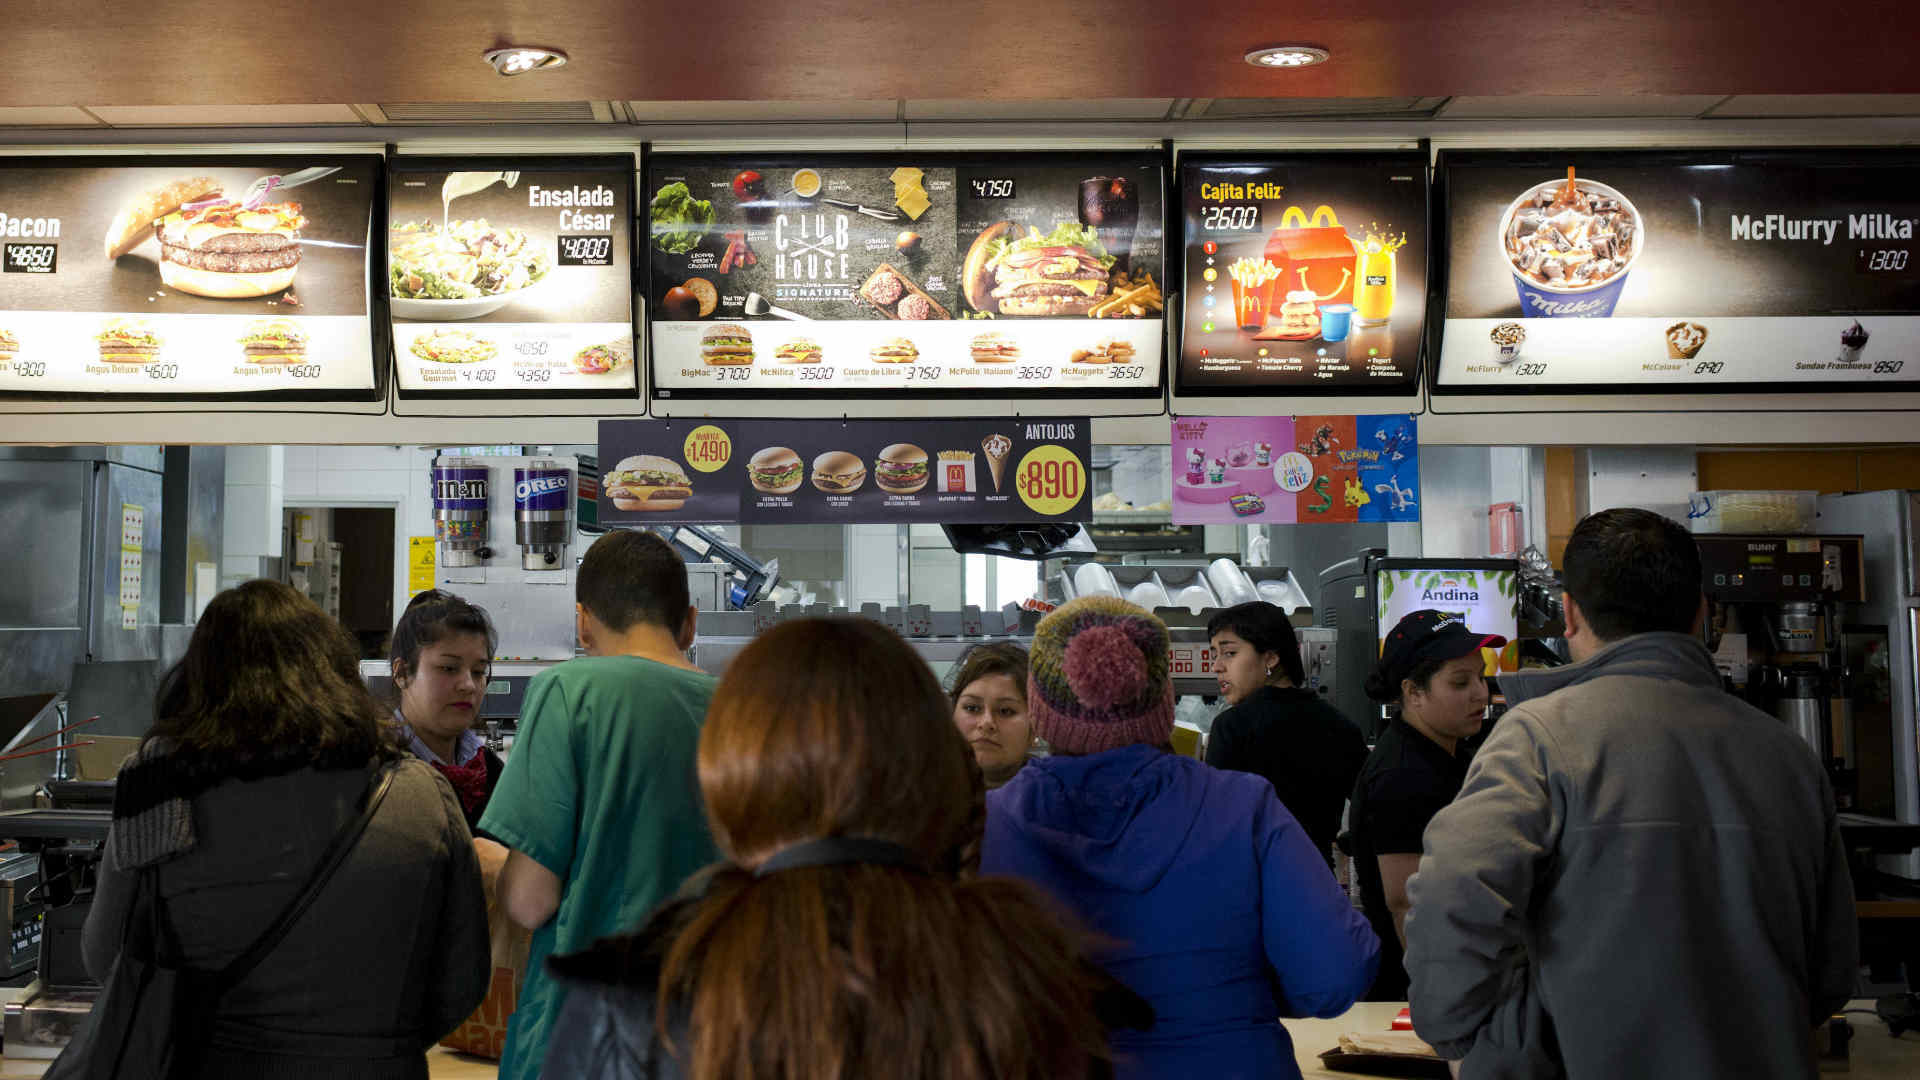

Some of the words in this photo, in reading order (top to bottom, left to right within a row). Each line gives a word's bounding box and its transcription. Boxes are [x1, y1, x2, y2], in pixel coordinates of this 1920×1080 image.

[529, 185, 614, 207] Ensalada
[1201, 183, 1244, 203] Cajita
[1247, 183, 1281, 199] Feliz
[0, 212, 60, 237] Bacon
[560, 209, 615, 230] César
[1731, 214, 1836, 245] McFlurry
[1848, 214, 1913, 239] Milka
[776, 214, 848, 251] CLUB
[776, 288, 848, 297] SIGNATURE
[871, 367, 880, 375] de
[1025, 423, 1075, 440] ANTOJOS
[515, 478, 568, 502] OREO
[1019, 460, 1079, 499] $890
[1421, 589, 1479, 601] Andina
